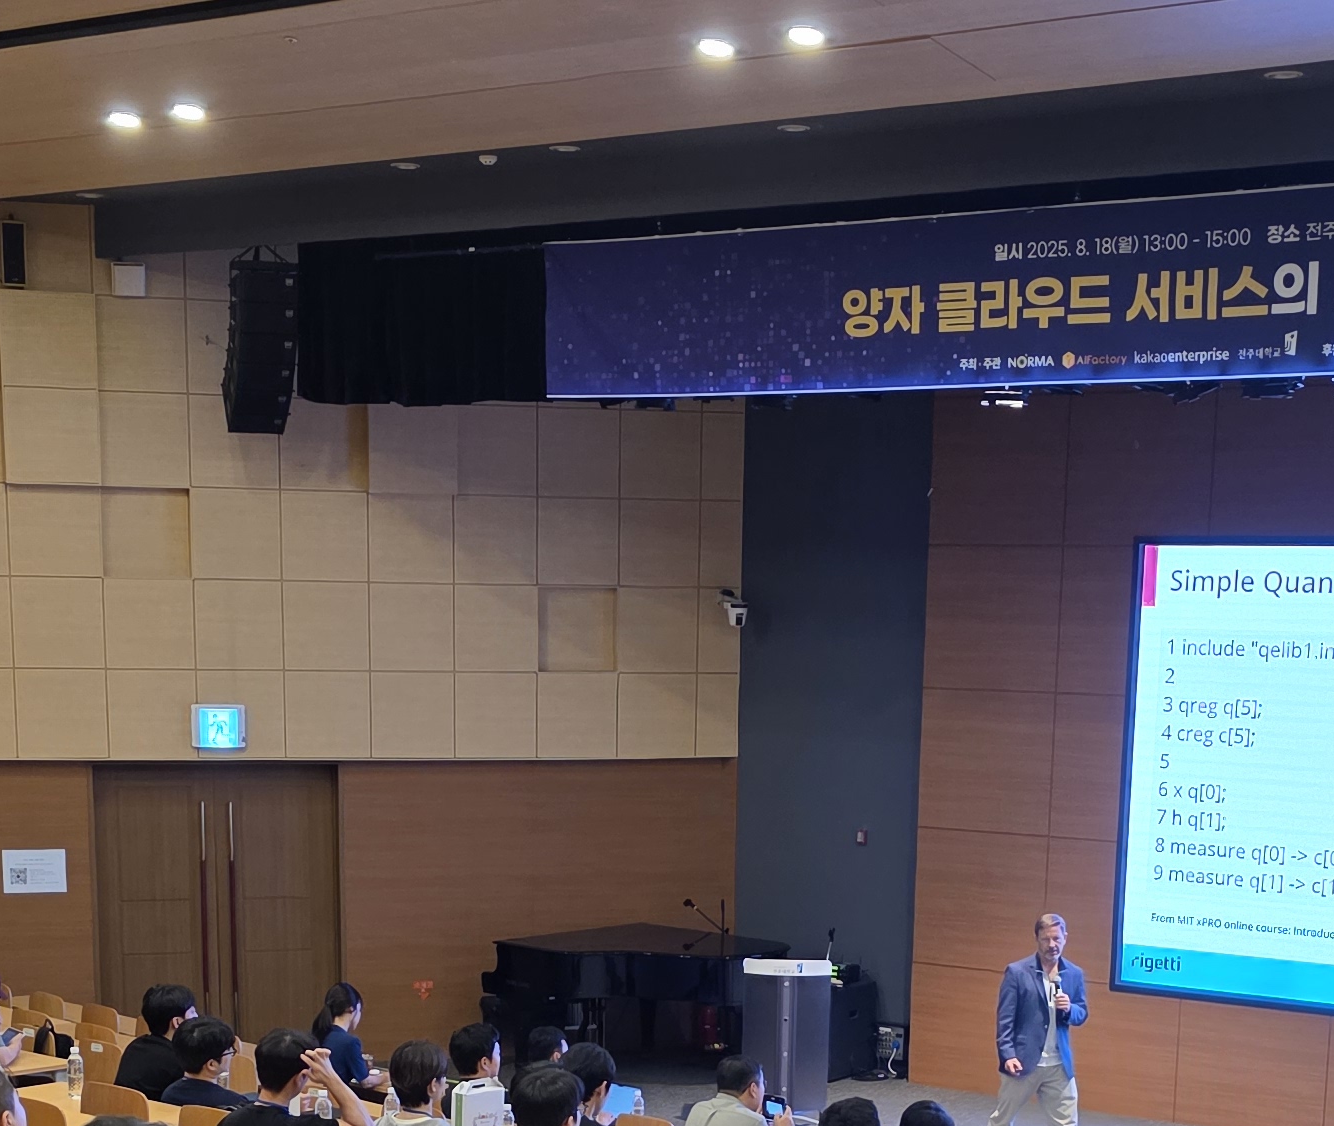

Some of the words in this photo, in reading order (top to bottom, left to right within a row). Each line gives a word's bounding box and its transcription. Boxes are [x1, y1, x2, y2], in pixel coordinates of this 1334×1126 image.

[994, 241, 1023, 262] 일시
[1027, 239, 1072, 259] 2025.
[1076, 238, 1090, 256] 8.
[1095, 234, 1139, 257] 18(월)
[1143, 231, 1187, 252] 13:00
[1205, 226, 1251, 248] 15:00
[1267, 224, 1300, 245] 장소
[842, 284, 924, 337] 양자
[936, 274, 1111, 333] 클라우드
[1125, 260, 1319, 322] 서비스의
[1008, 353, 1054, 369] NORMA
[1133, 347, 1230, 364] kakaoenterprise
[1171, 568, 1254, 599] Simple
[1183, 638, 1245, 657] include
[1165, 667, 1174, 685] 2
[1163, 696, 1172, 713] 3
[1179, 700, 1217, 719] qreg
[1224, 698, 1262, 720] q[5];
[1161, 724, 1172, 741] 4
[1178, 728, 1214, 748] creg
[1219, 727, 1255, 748] c[5];
[1160, 753, 1169, 769] 5
[1159, 781, 1167, 797] 6
[1174, 785, 1182, 799] x
[1188, 783, 1226, 804] q[0];
[1157, 808, 1166, 825] 7
[1172, 808, 1181, 826] h
[1188, 811, 1226, 832] q[1];
[1155, 837, 1164, 853] 8
[1171, 841, 1245, 860] measure
[1252, 844, 1285, 866] q[0]
[1154, 864, 1162, 881] 9
[1169, 869, 1243, 888] measure
[1250, 873, 1283, 894] q[1]
[1151, 912, 1174, 924] From
[1178, 915, 1194, 926] MIT
[1197, 917, 1221, 929] xPRO
[1224, 920, 1253, 932] online
[1256, 924, 1290, 935] course:
[1132, 952, 1180, 973] rigetti
